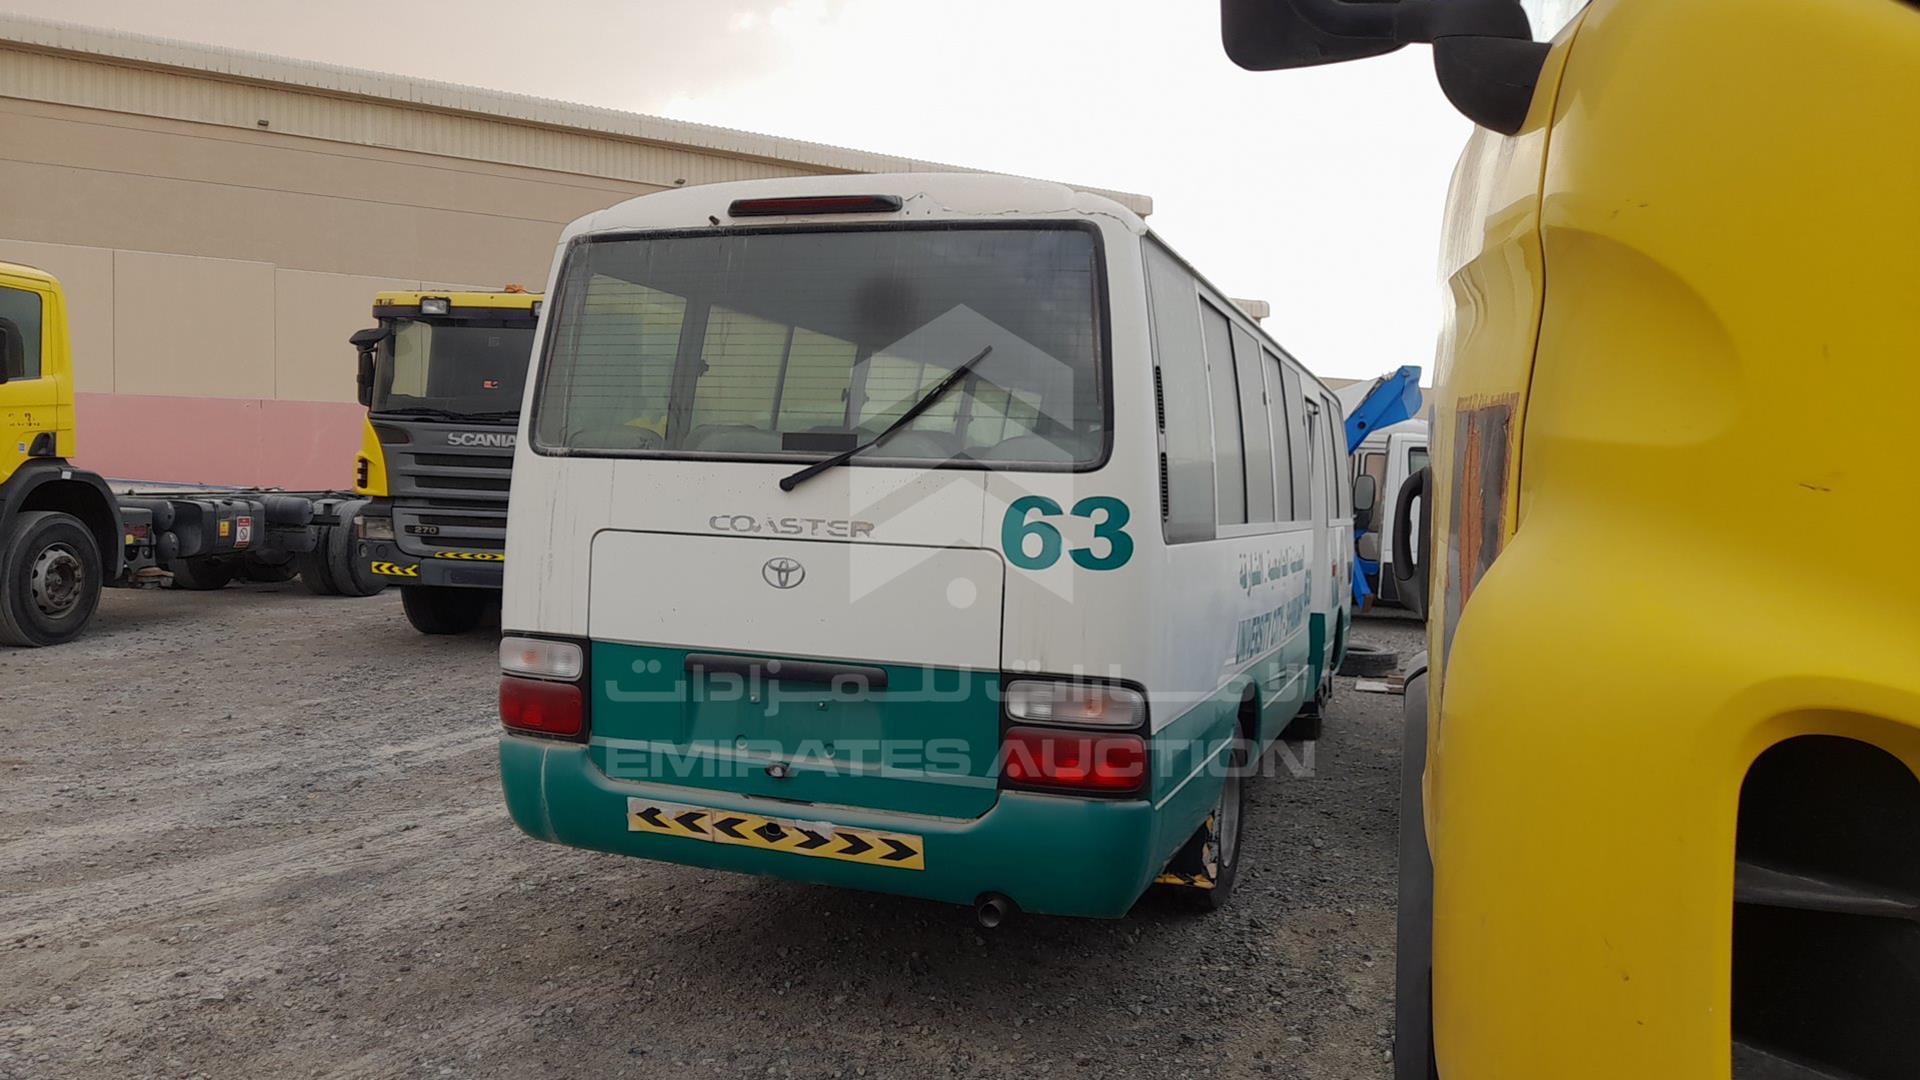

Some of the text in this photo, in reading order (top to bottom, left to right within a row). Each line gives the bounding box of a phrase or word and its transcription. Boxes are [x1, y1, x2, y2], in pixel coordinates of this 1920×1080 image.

[447, 432, 517, 447] SCANIA
[414, 526, 437, 535] 270
[709, 515, 875, 538] COASTER
[1002, 495, 1134, 571] 63
